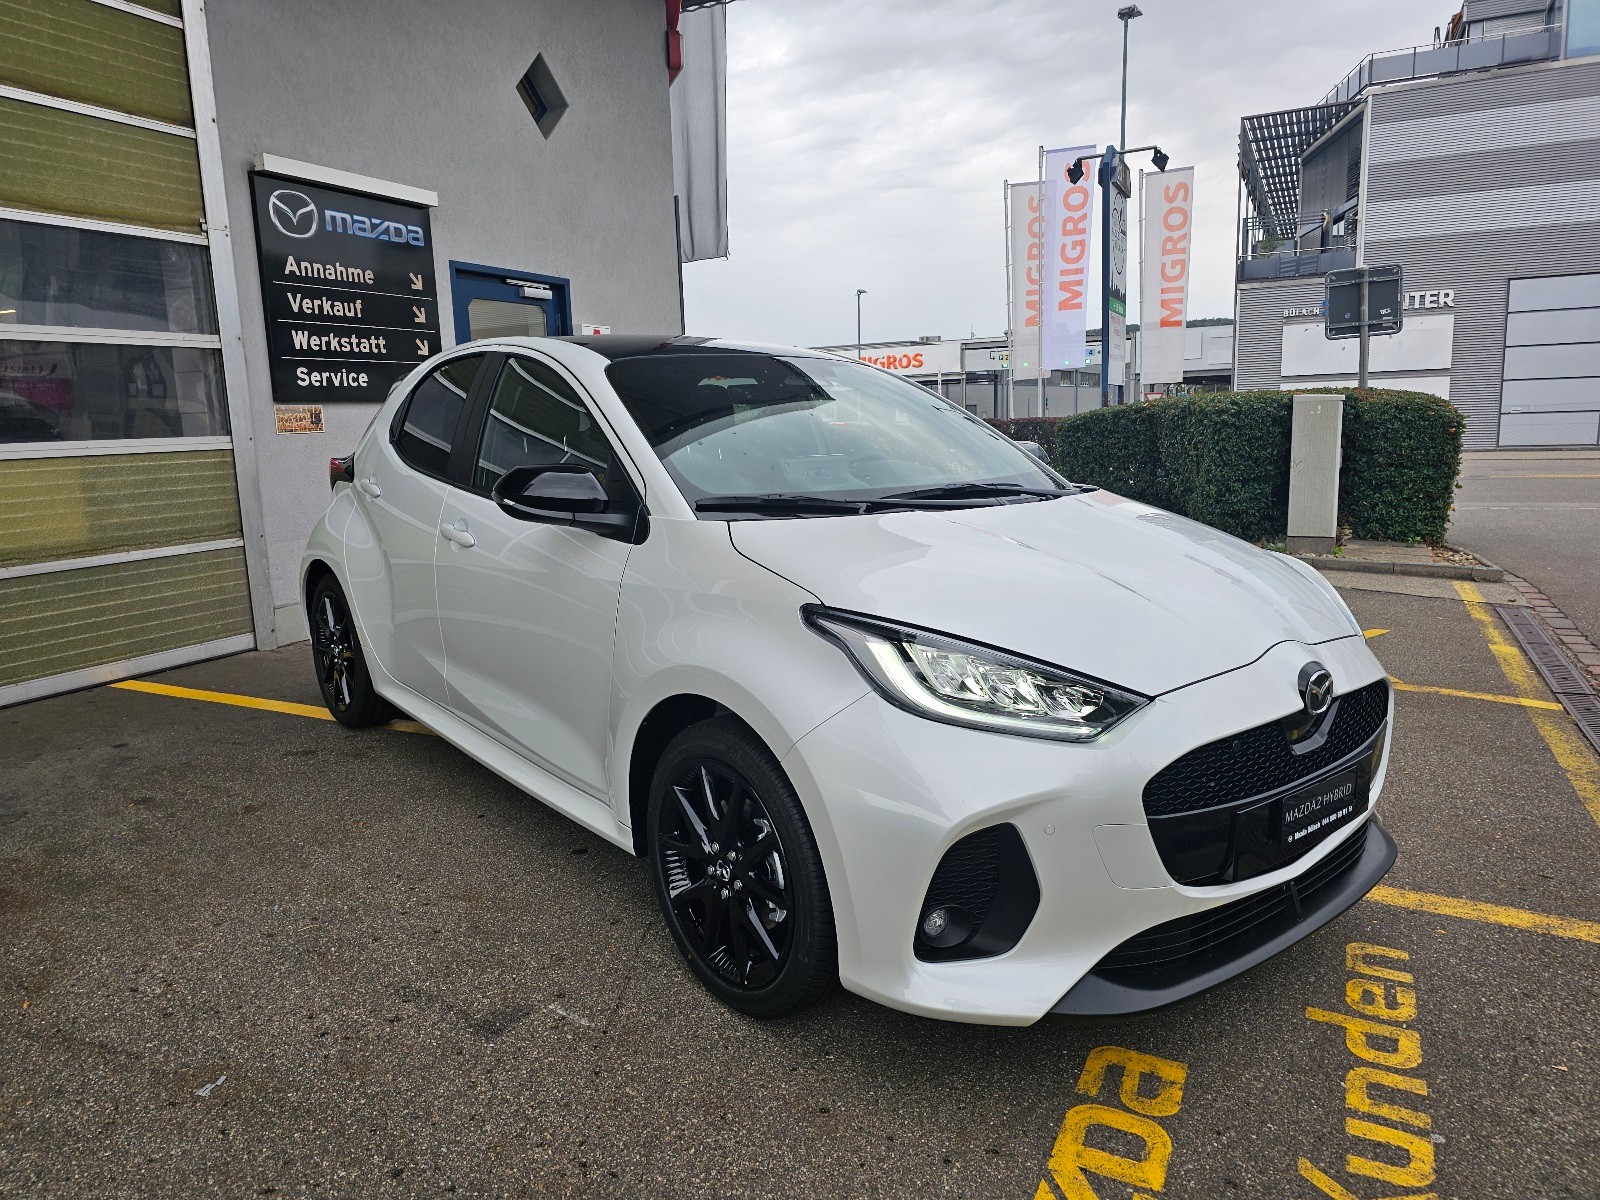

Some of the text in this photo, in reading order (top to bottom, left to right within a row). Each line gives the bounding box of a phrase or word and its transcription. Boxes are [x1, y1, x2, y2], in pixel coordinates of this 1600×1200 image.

[1159, 181, 1190, 328] MIGROS
[284, 255, 375, 285] Annahme
[287, 292, 363, 318] Verkauf
[291, 330, 387, 354] Werkstatt
[296, 366, 369, 388] Service
[1285, 783, 1352, 824] MAZDA2 HYBRID
